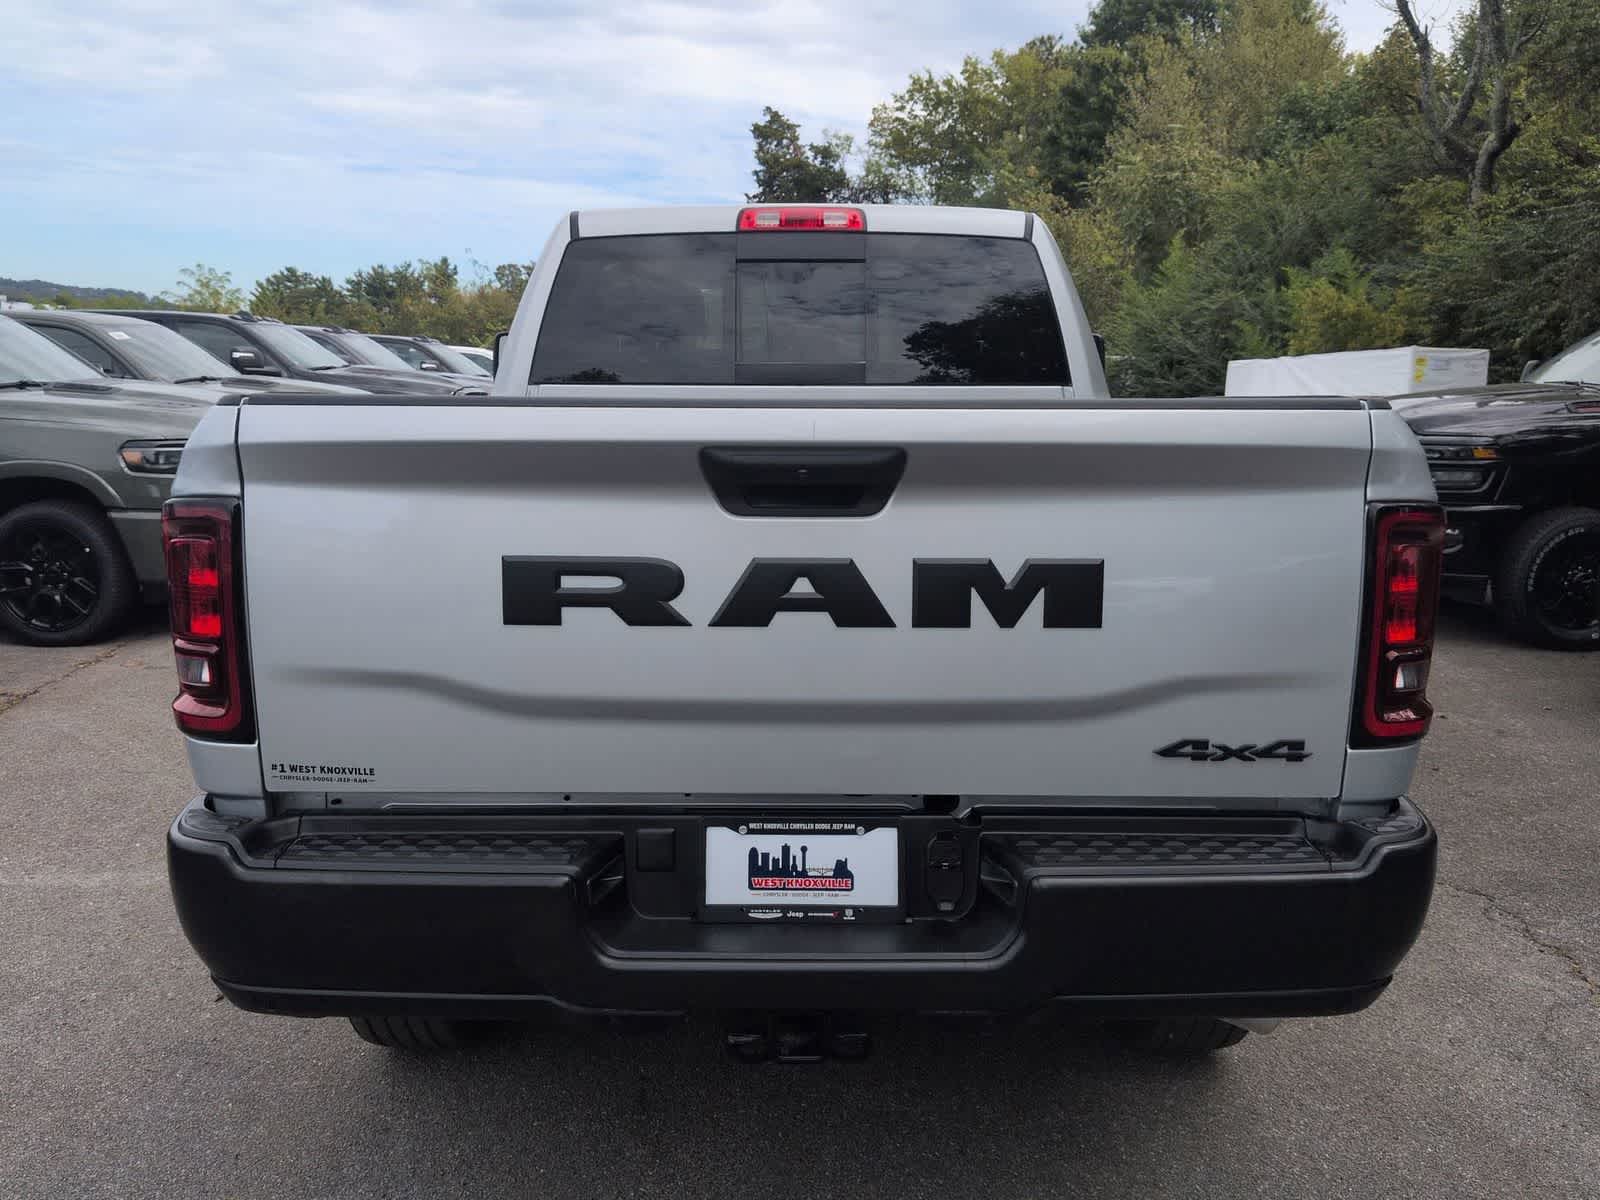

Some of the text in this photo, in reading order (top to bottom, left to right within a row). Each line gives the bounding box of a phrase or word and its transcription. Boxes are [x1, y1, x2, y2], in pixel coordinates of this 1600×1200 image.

[501, 555, 1105, 628] RAM
[1152, 738, 1313, 762] 4x4
[271, 763, 375, 776] #1 WEST KNOXVILLE
[752, 877, 852, 889] WEST KNOXVILLE
[786, 910, 804, 918] Jeep
